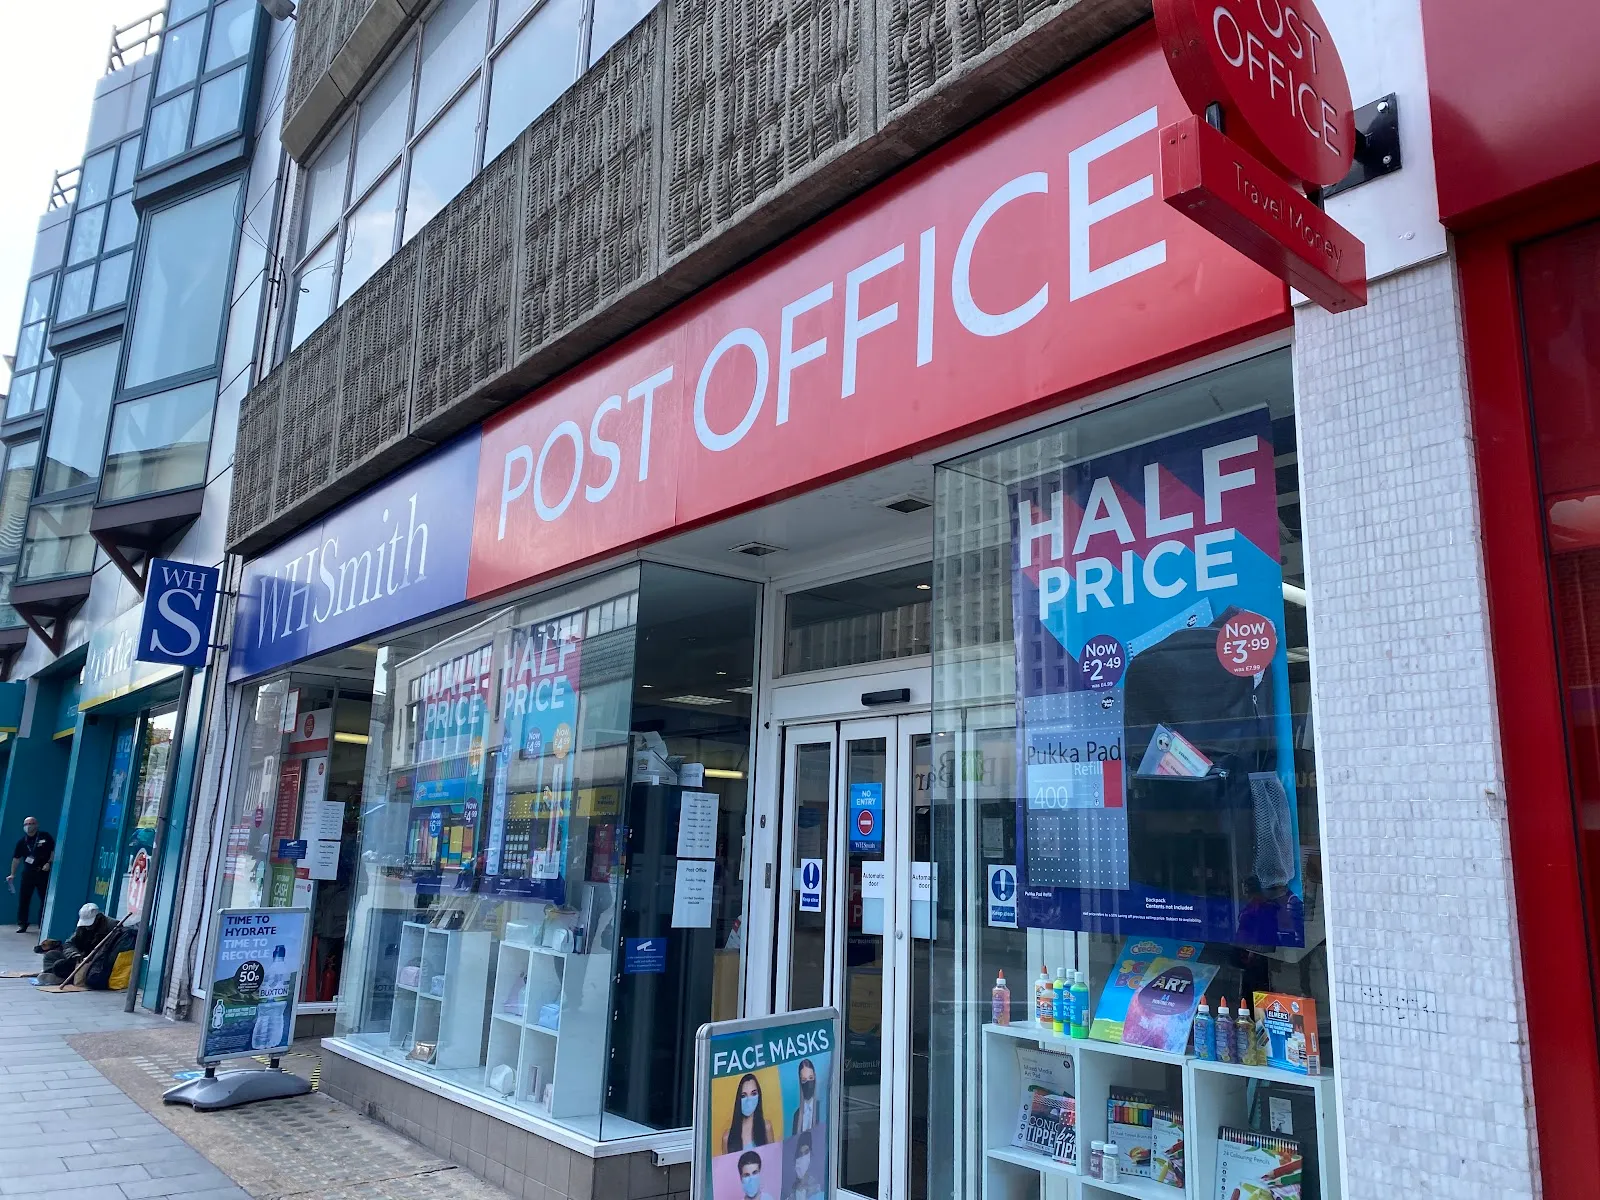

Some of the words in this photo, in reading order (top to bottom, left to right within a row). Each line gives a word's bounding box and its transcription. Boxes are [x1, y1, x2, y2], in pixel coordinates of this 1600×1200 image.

[1236, 0, 1322, 74] OST
[1213, 6, 1340, 156] OFFICE
[1233, 161, 1285, 223] Travel
[1289, 208, 1343, 272] Money
[497, 365, 674, 541] POST
[693, 106, 1167, 452] OFFICE
[1018, 434, 1259, 569] HALF
[161, 566, 208, 591] WH
[258, 492, 429, 649] WHSmith
[1038, 527, 1238, 621] PRICE
[149, 588, 202, 657] S
[503, 624, 579, 686] HALF
[1223, 637, 1270, 663] £3.99
[1082, 656, 1121, 681] £2.49
[503, 675, 567, 719] PRICE
[425, 693, 481, 732] PRICE
[1027, 742, 1080, 765] Pukka
[1086, 737, 1121, 762] Pad
[1074, 762, 1103, 776] Refill
[856, 797, 876, 806] ENTRY
[861, 790, 872, 798] NO
[1034, 786, 1068, 809] 400
[225, 926, 277, 937] HYDRATE
[226, 916, 252, 925] TIME
[255, 915, 270, 924] TO
[221, 949, 273, 961] RECYCLE
[223, 938, 251, 949] TIME
[251, 938, 269, 947] TO
[1180, 946, 1193, 954] 32
[238, 971, 260, 983] 50p
[242, 963, 260, 973] Only
[260, 986, 288, 997] BUXTON
[1151, 976, 1192, 994] ART
[1268, 1010, 1289, 1020] ELMER'S
[713, 1043, 766, 1075] FACE
[769, 1028, 829, 1063] MASKS
[1023, 1064, 1038, 1072] Mixed
[1038, 1067, 1053, 1075] Media
[1026, 1126, 1059, 1148] TIPPE
[1230, 1151, 1253, 1162] Colouring
[1253, 1156, 1271, 1165] Pencils
